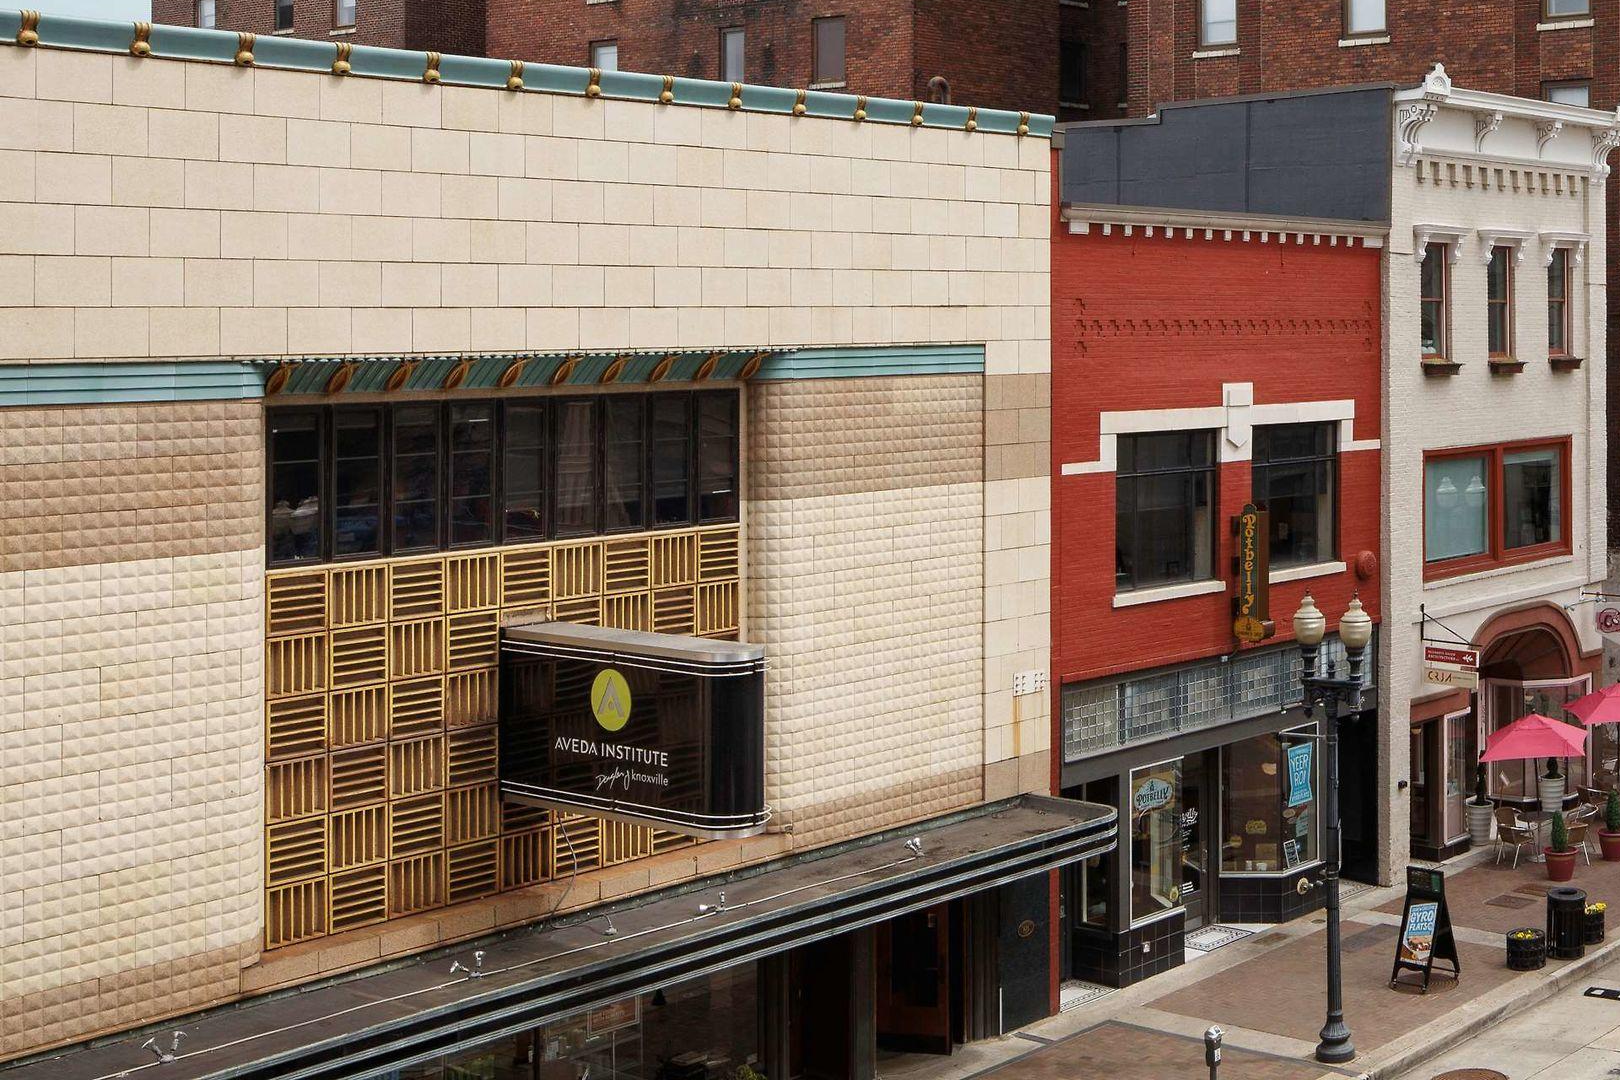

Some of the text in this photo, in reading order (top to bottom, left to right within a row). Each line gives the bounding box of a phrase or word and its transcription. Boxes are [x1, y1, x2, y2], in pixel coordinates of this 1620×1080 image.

[554, 736, 669, 768] AVEDA INSTITUTE
[631, 768, 669, 787] knoxville
[1410, 910, 1434, 923] GYRO
